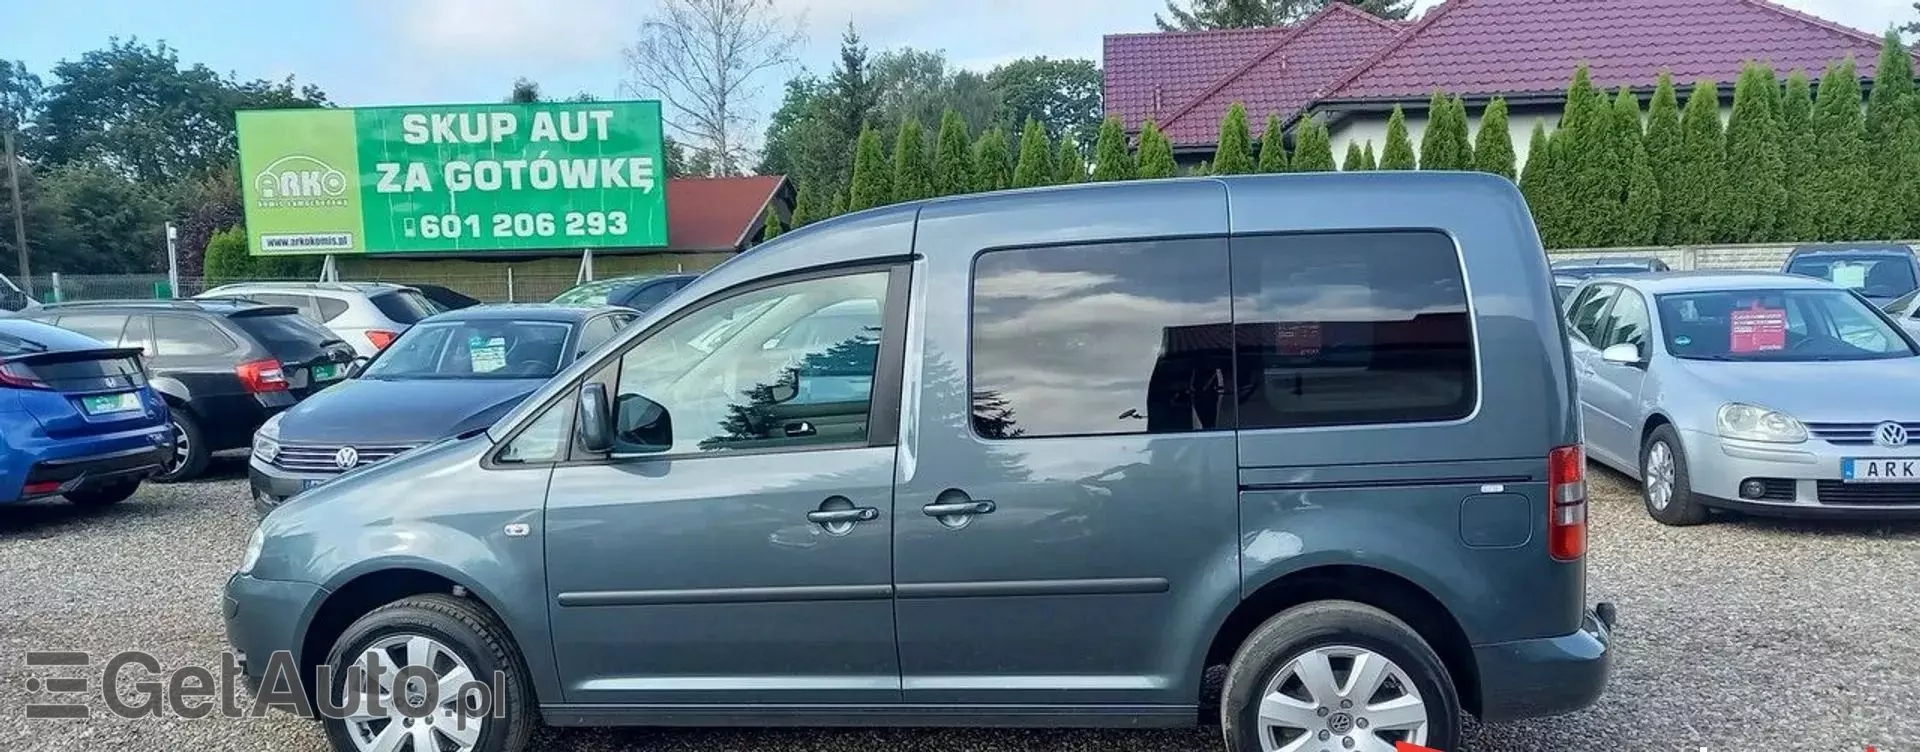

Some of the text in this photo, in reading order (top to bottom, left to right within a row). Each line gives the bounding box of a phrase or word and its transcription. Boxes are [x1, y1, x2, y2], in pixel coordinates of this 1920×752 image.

[403, 110, 614, 145] SKUP AUT
[255, 169, 347, 197] ARKO
[376, 149, 655, 195] ZA GOTÓWKĘ
[420, 212, 628, 239] 601 206 293
[266, 235, 348, 247] www.arkokomis.pl
